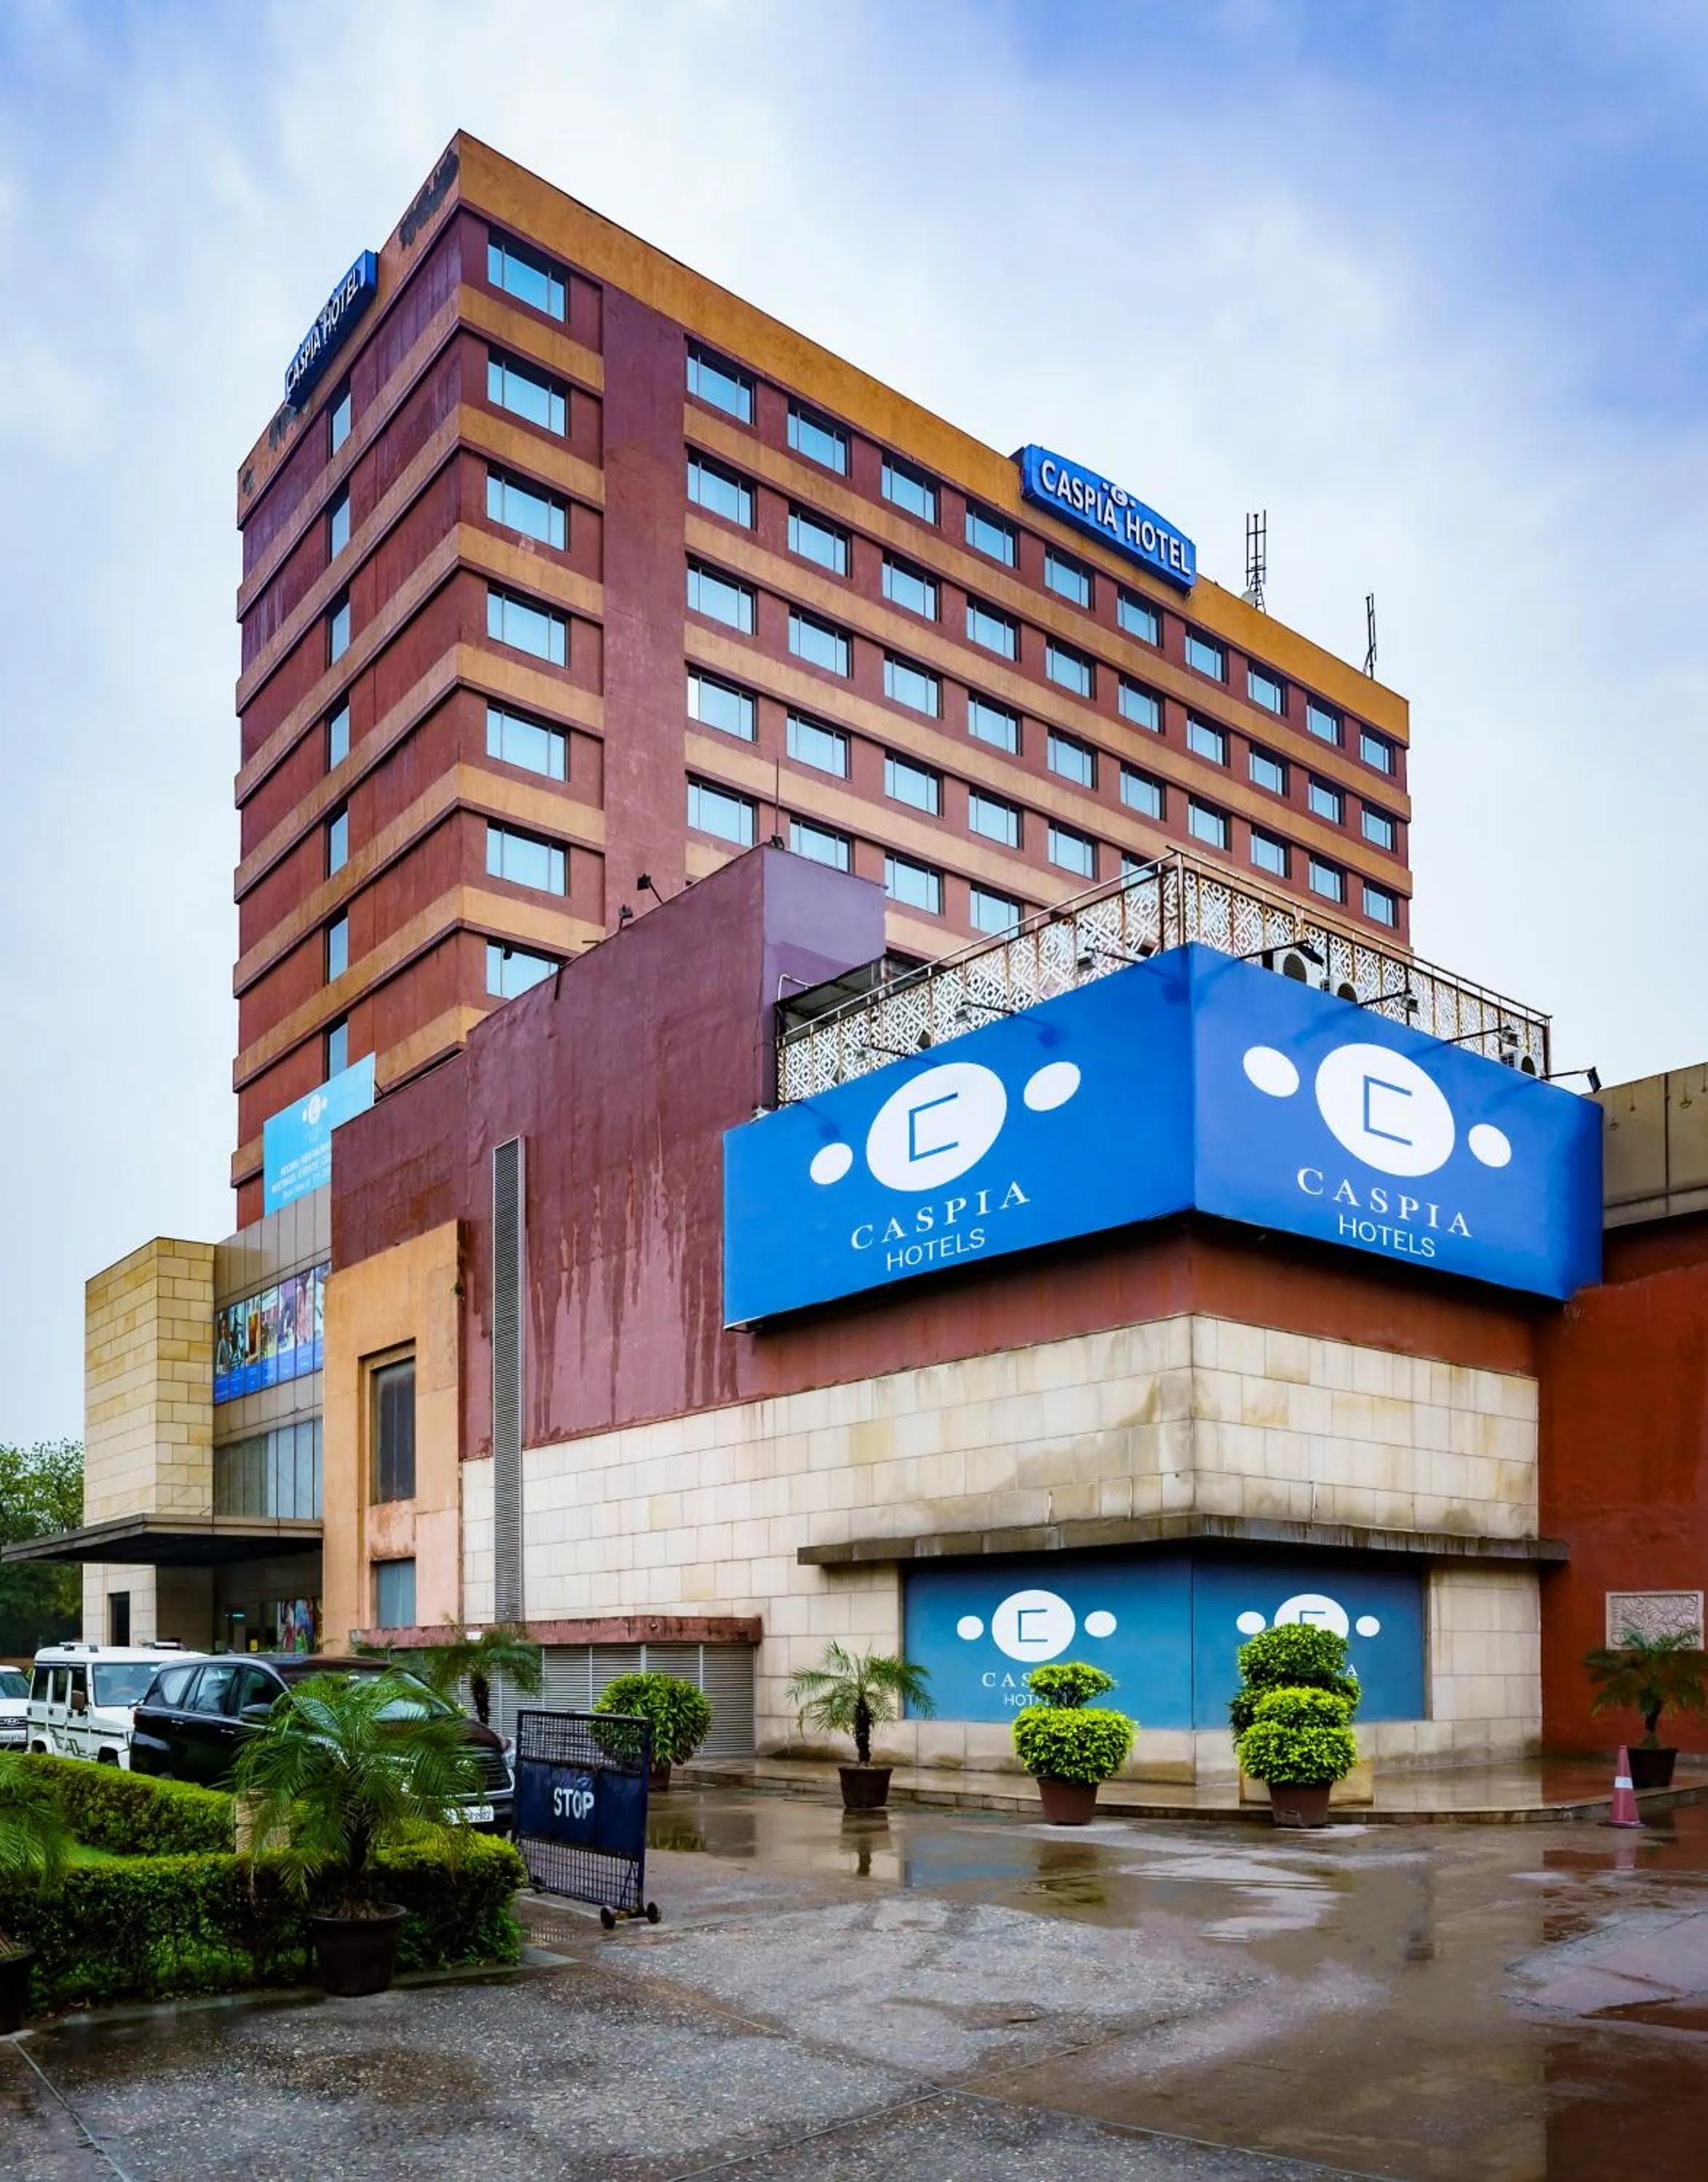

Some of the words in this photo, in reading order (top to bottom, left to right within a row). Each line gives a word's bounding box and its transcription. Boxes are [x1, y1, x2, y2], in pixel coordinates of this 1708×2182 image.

[287, 324, 321, 391] CASPIA
[322, 267, 359, 344] HOTEL
[1041, 459, 1117, 532] CASPIA
[1127, 510, 1191, 575] HOTEL
[850, 1180, 1031, 1250] CASPIA
[1297, 1167, 1472, 1237] CASPIA
[887, 1228, 986, 1272] HOTELS
[1339, 1213, 1435, 1258] HOTELS
[982, 1672, 1031, 1688] CAS
[553, 1786, 595, 1820] STOP
